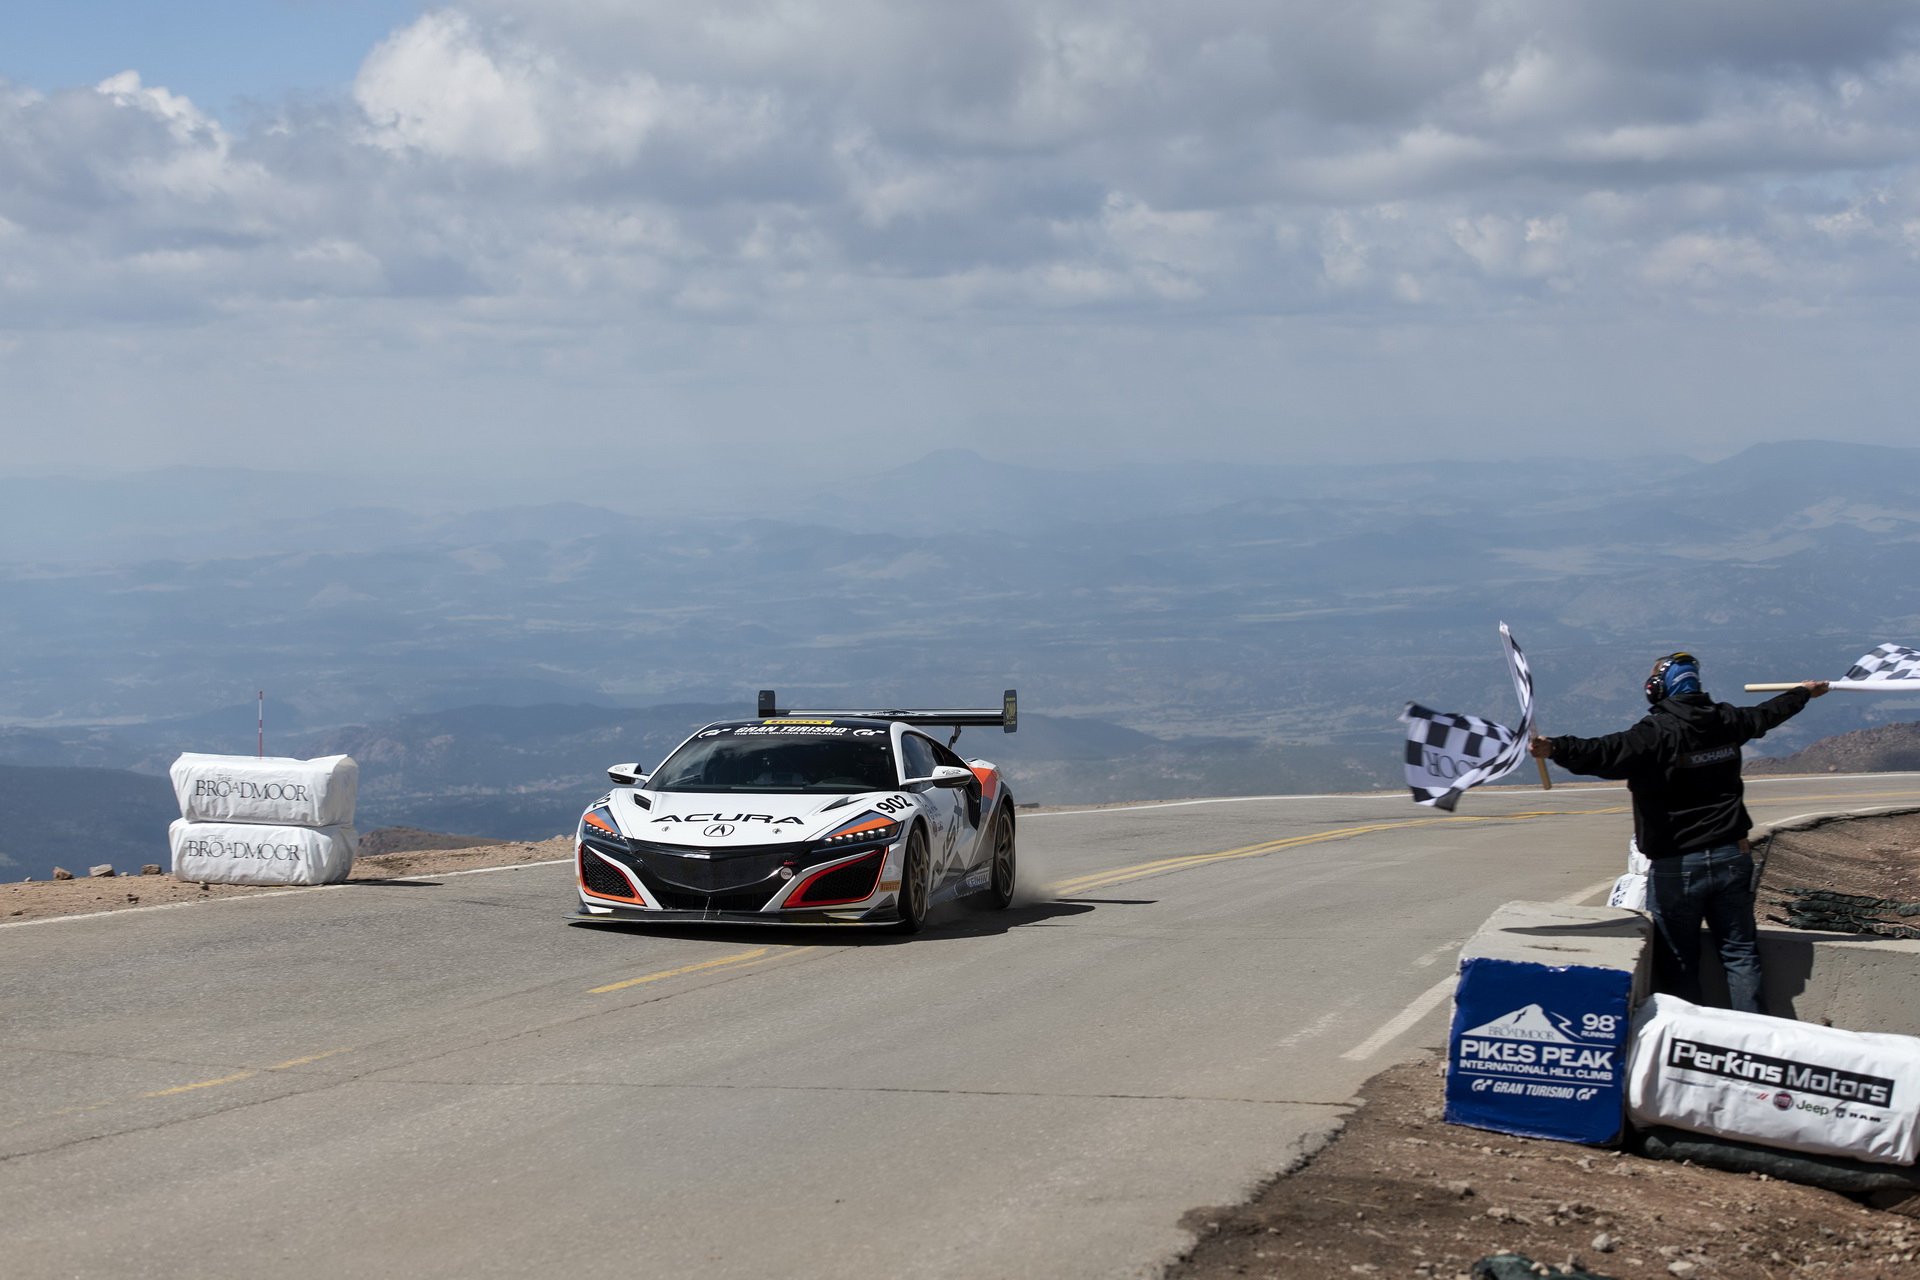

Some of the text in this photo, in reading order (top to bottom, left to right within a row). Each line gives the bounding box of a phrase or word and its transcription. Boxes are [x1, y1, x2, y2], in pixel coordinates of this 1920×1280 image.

[195, 779, 309, 802] BROADMOOR
[876, 795, 914, 814] 902
[650, 813, 805, 825] ACURA
[188, 840, 301, 861] BROADMOOR
[1488, 1026, 1555, 1040] BROADMOOR
[1580, 1030, 1616, 1039] RUNNING
[1460, 1040, 1613, 1070] PIKES PEAK
[1459, 1059, 1613, 1081] INTERNATIONAL HILL CLIMB
[1672, 1041, 1784, 1083] Perkins
[1786, 1064, 1888, 1103] Motors
[1493, 1081, 1524, 1095] GRAN
[1526, 1084, 1574, 1099] TURISMO
[1796, 1099, 1829, 1116] Jeep
[1849, 1112, 1881, 1123] RAM
